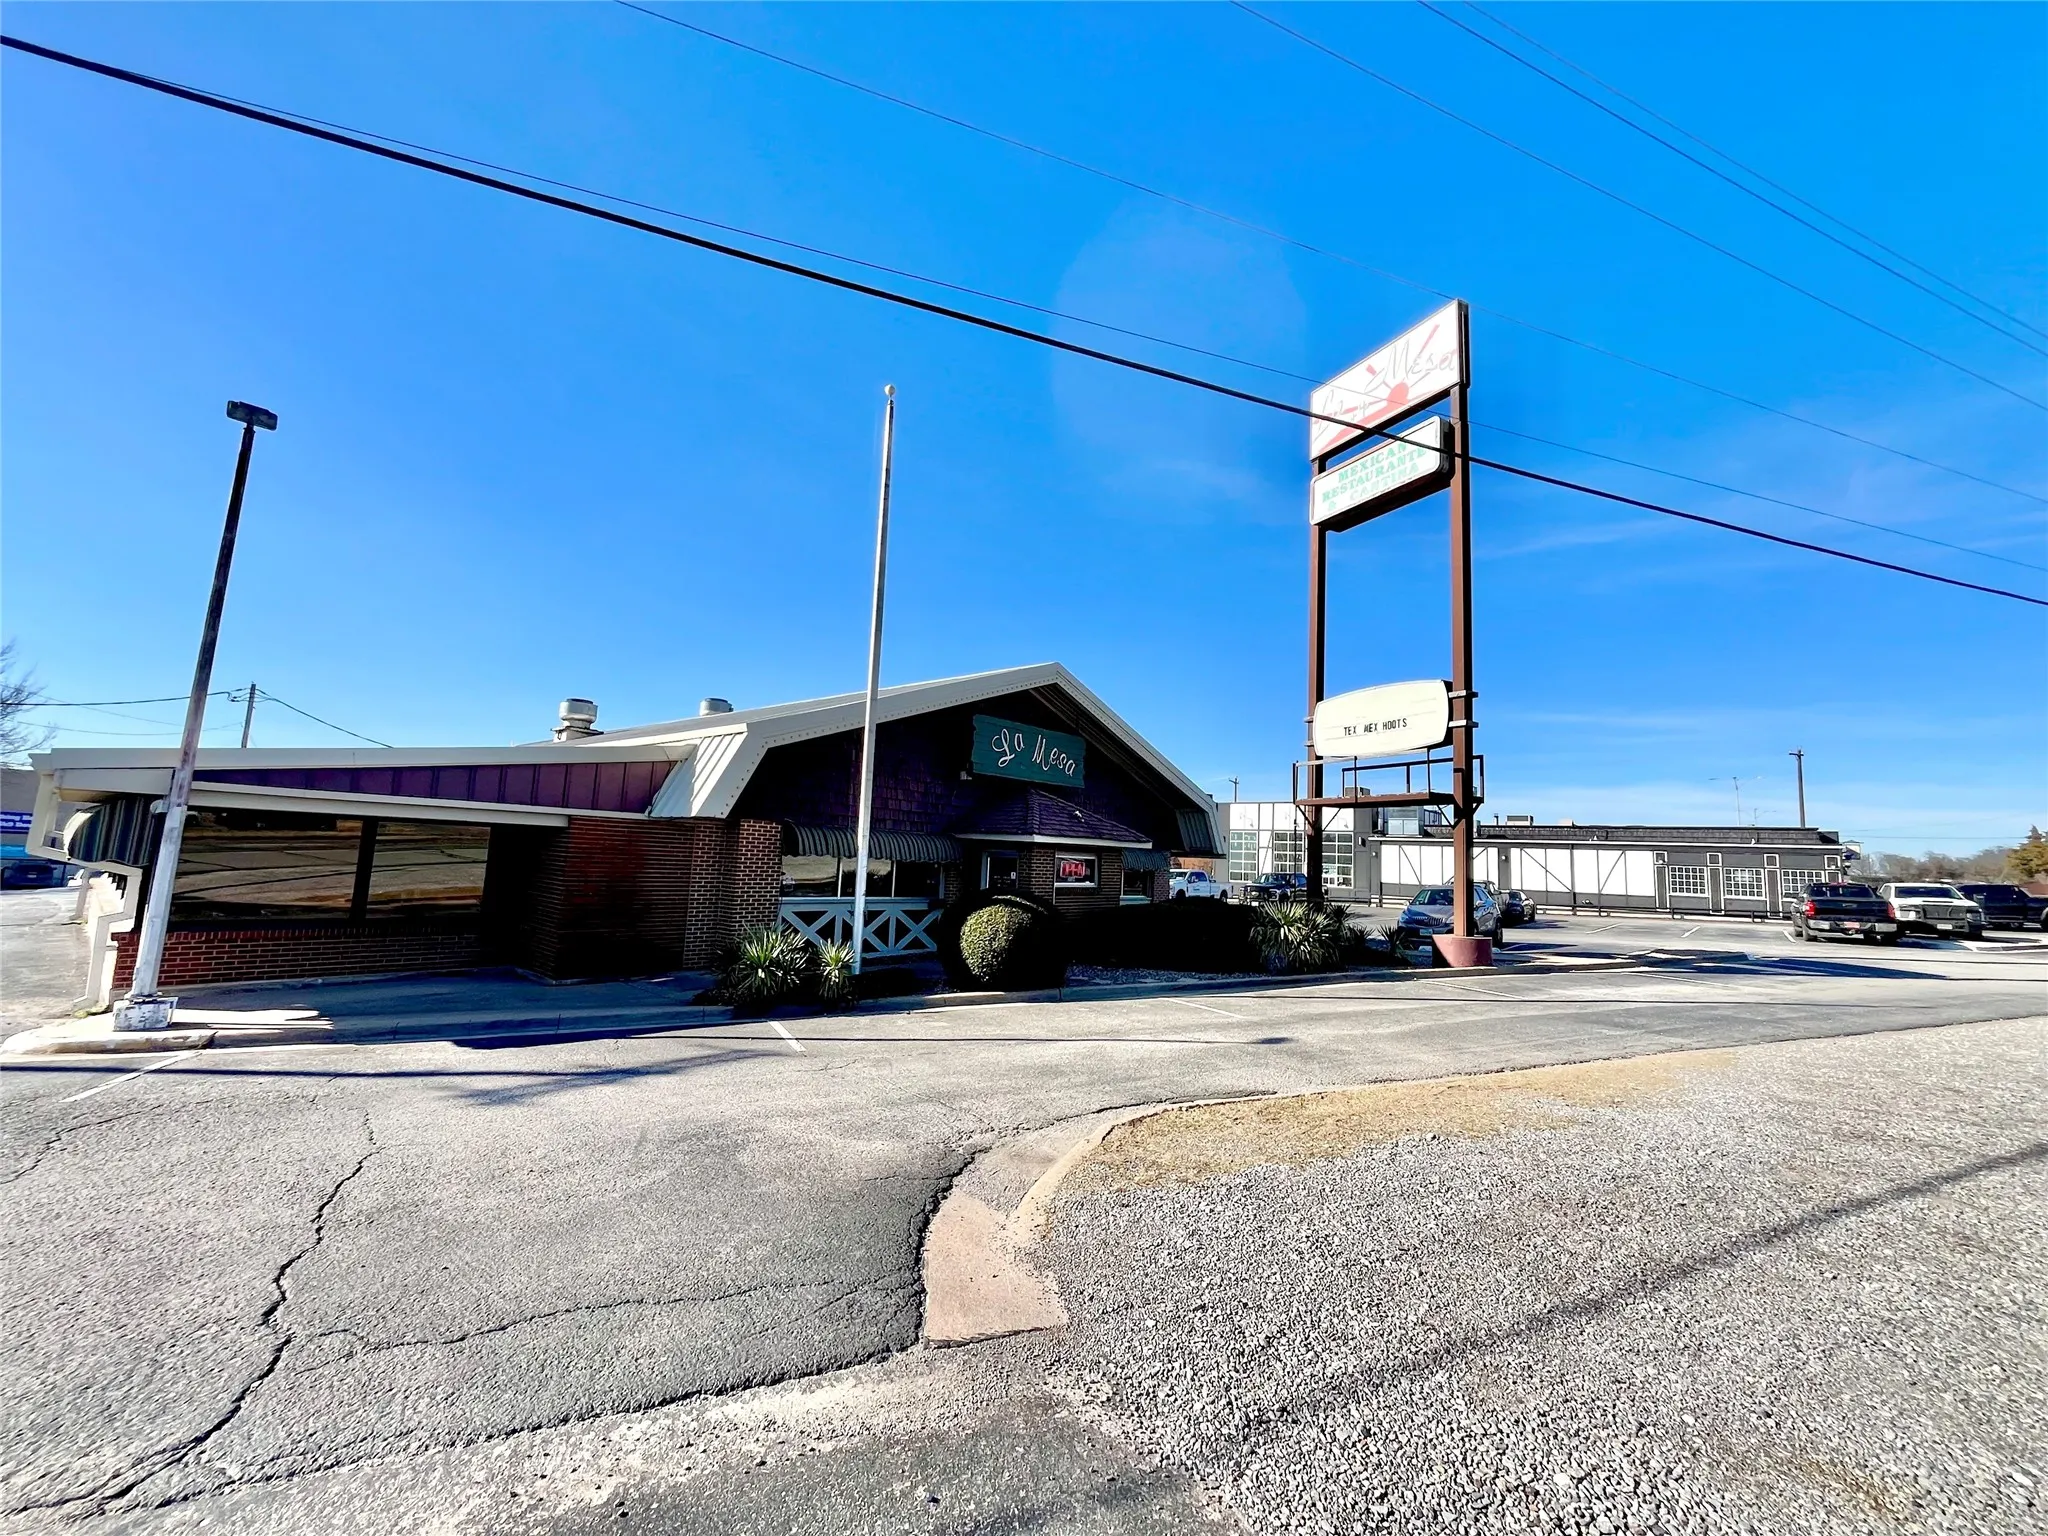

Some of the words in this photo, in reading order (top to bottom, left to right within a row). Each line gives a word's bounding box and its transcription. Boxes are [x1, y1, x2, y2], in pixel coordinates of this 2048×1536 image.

[1364, 338, 1455, 394] Mesa
[1322, 448, 1427, 504] RESTAURANTE
[1338, 440, 1407, 483] MEXICAN
[1350, 463, 1420, 501] CANTINA
[1343, 725, 1357, 736] TEX
[1363, 722, 1378, 734] MEX
[991, 728, 1025, 767] La
[1031, 734, 1076, 777] Mesa
